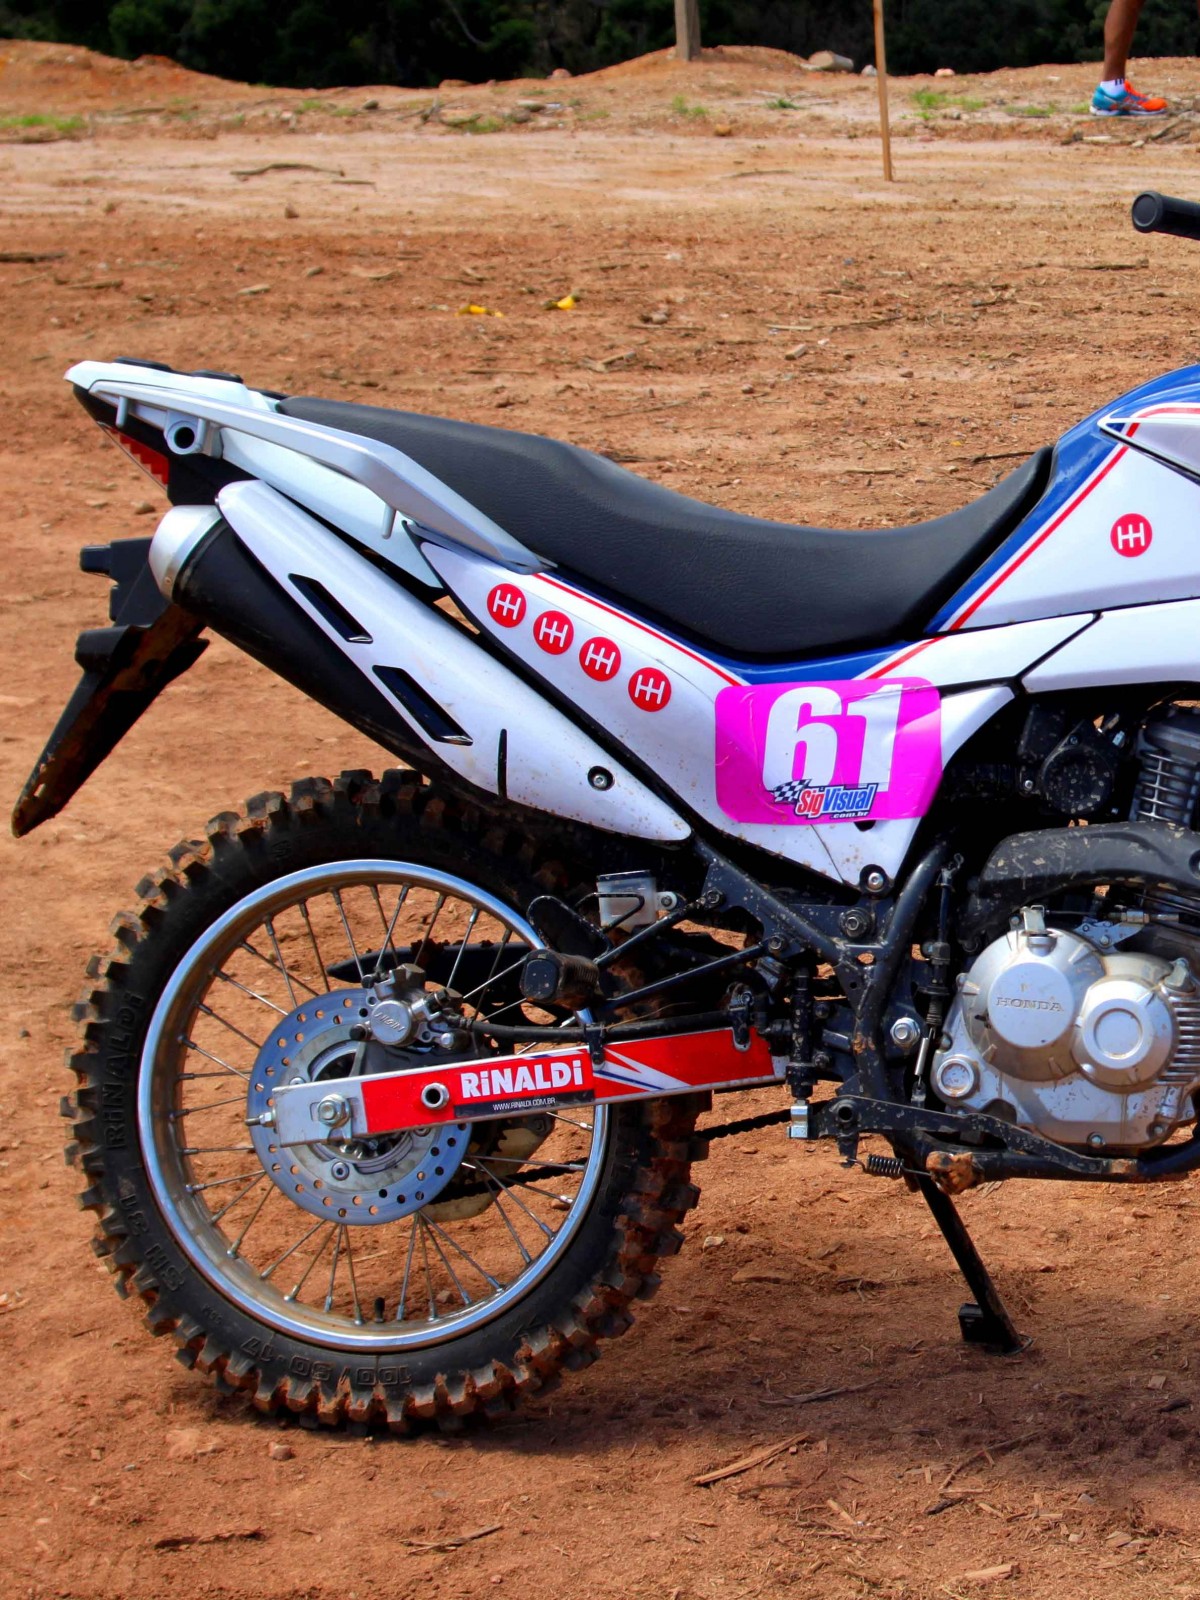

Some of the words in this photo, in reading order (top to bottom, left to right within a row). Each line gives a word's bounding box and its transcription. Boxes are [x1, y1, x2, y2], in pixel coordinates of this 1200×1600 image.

[762, 684, 903, 792] 61
[796, 784, 876, 818] SigVisual
[995, 996, 1065, 1012] HONDA
[492, 1096, 556, 1112] WWW.RINALDI.COM.BR
